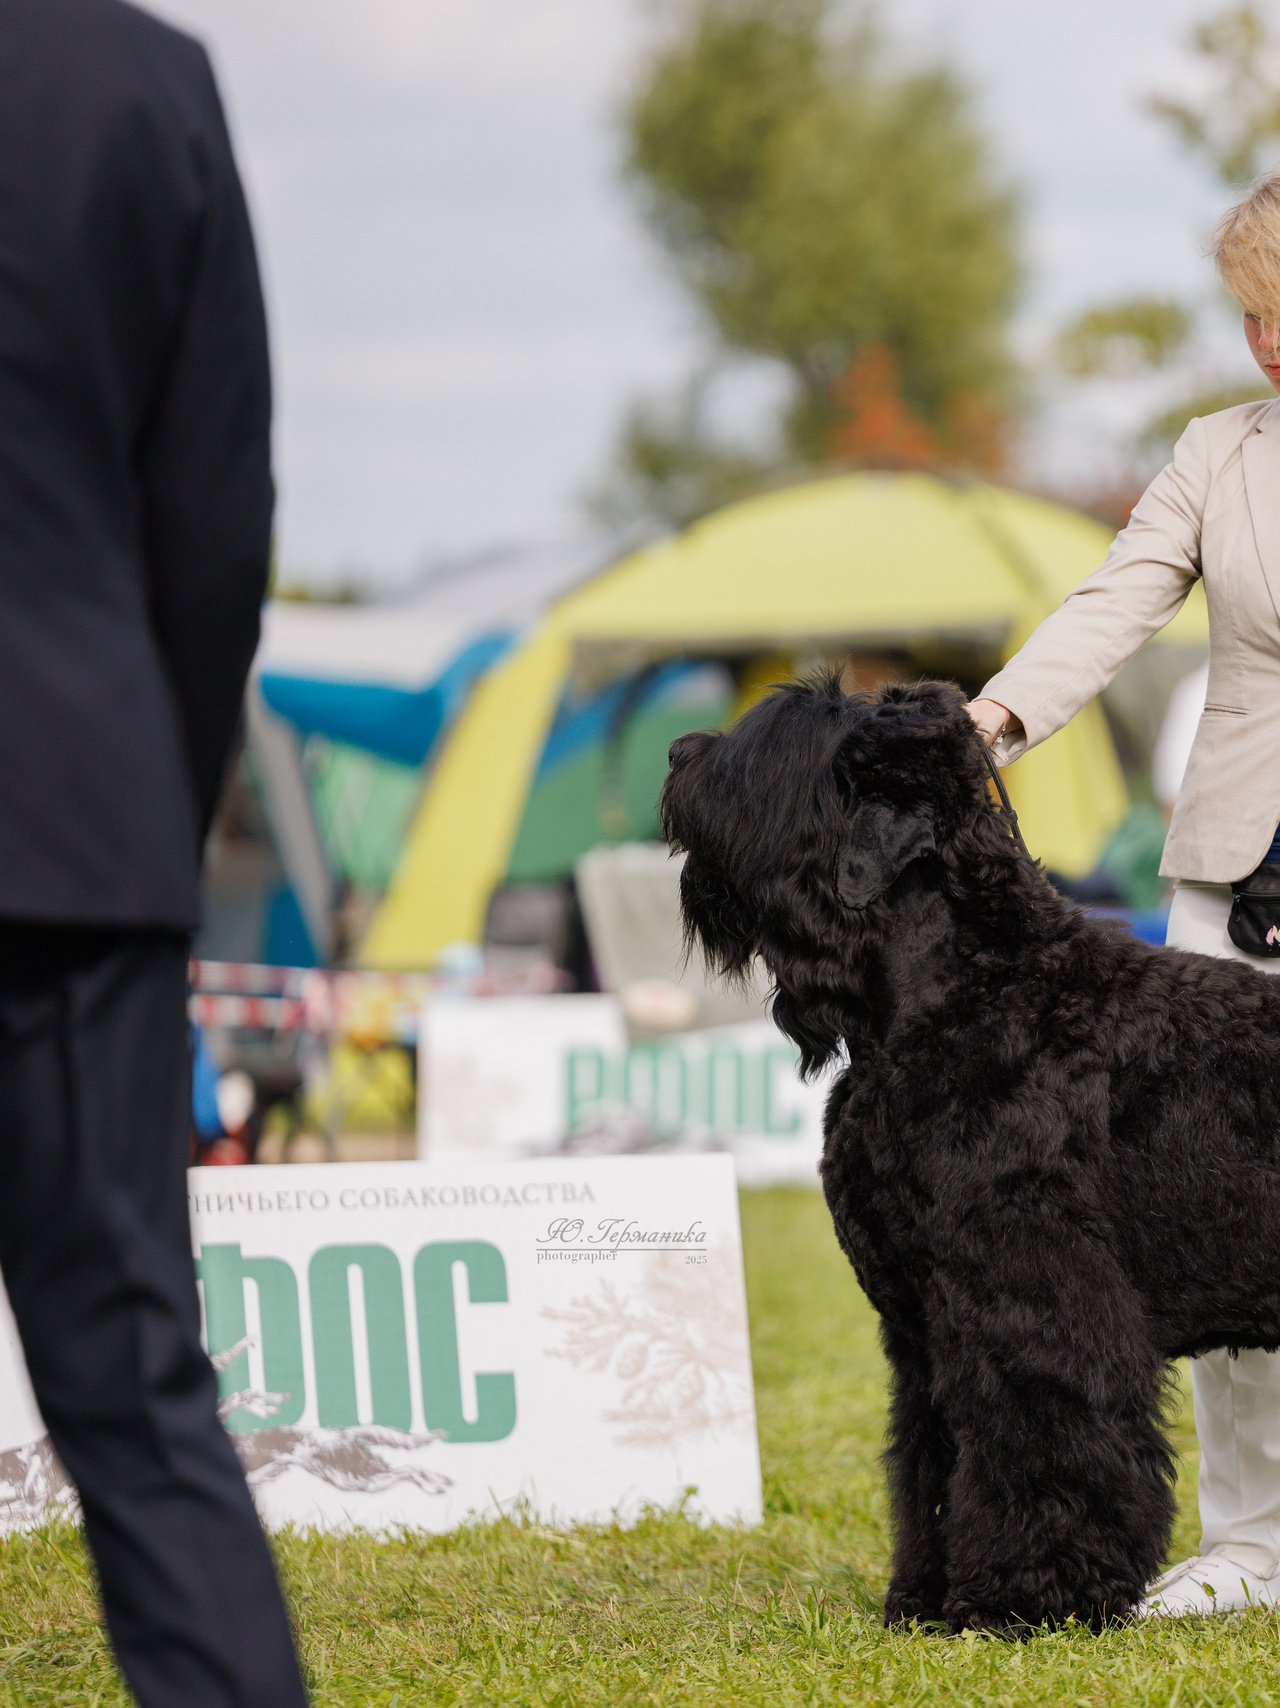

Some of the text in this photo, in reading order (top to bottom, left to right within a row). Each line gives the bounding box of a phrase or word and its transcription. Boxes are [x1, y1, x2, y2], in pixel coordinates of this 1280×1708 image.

[192, 1182, 598, 1214] НИЧЬЕГО СОБАКОВОДСТВА
[187, 1238, 516, 1444] ФОС
